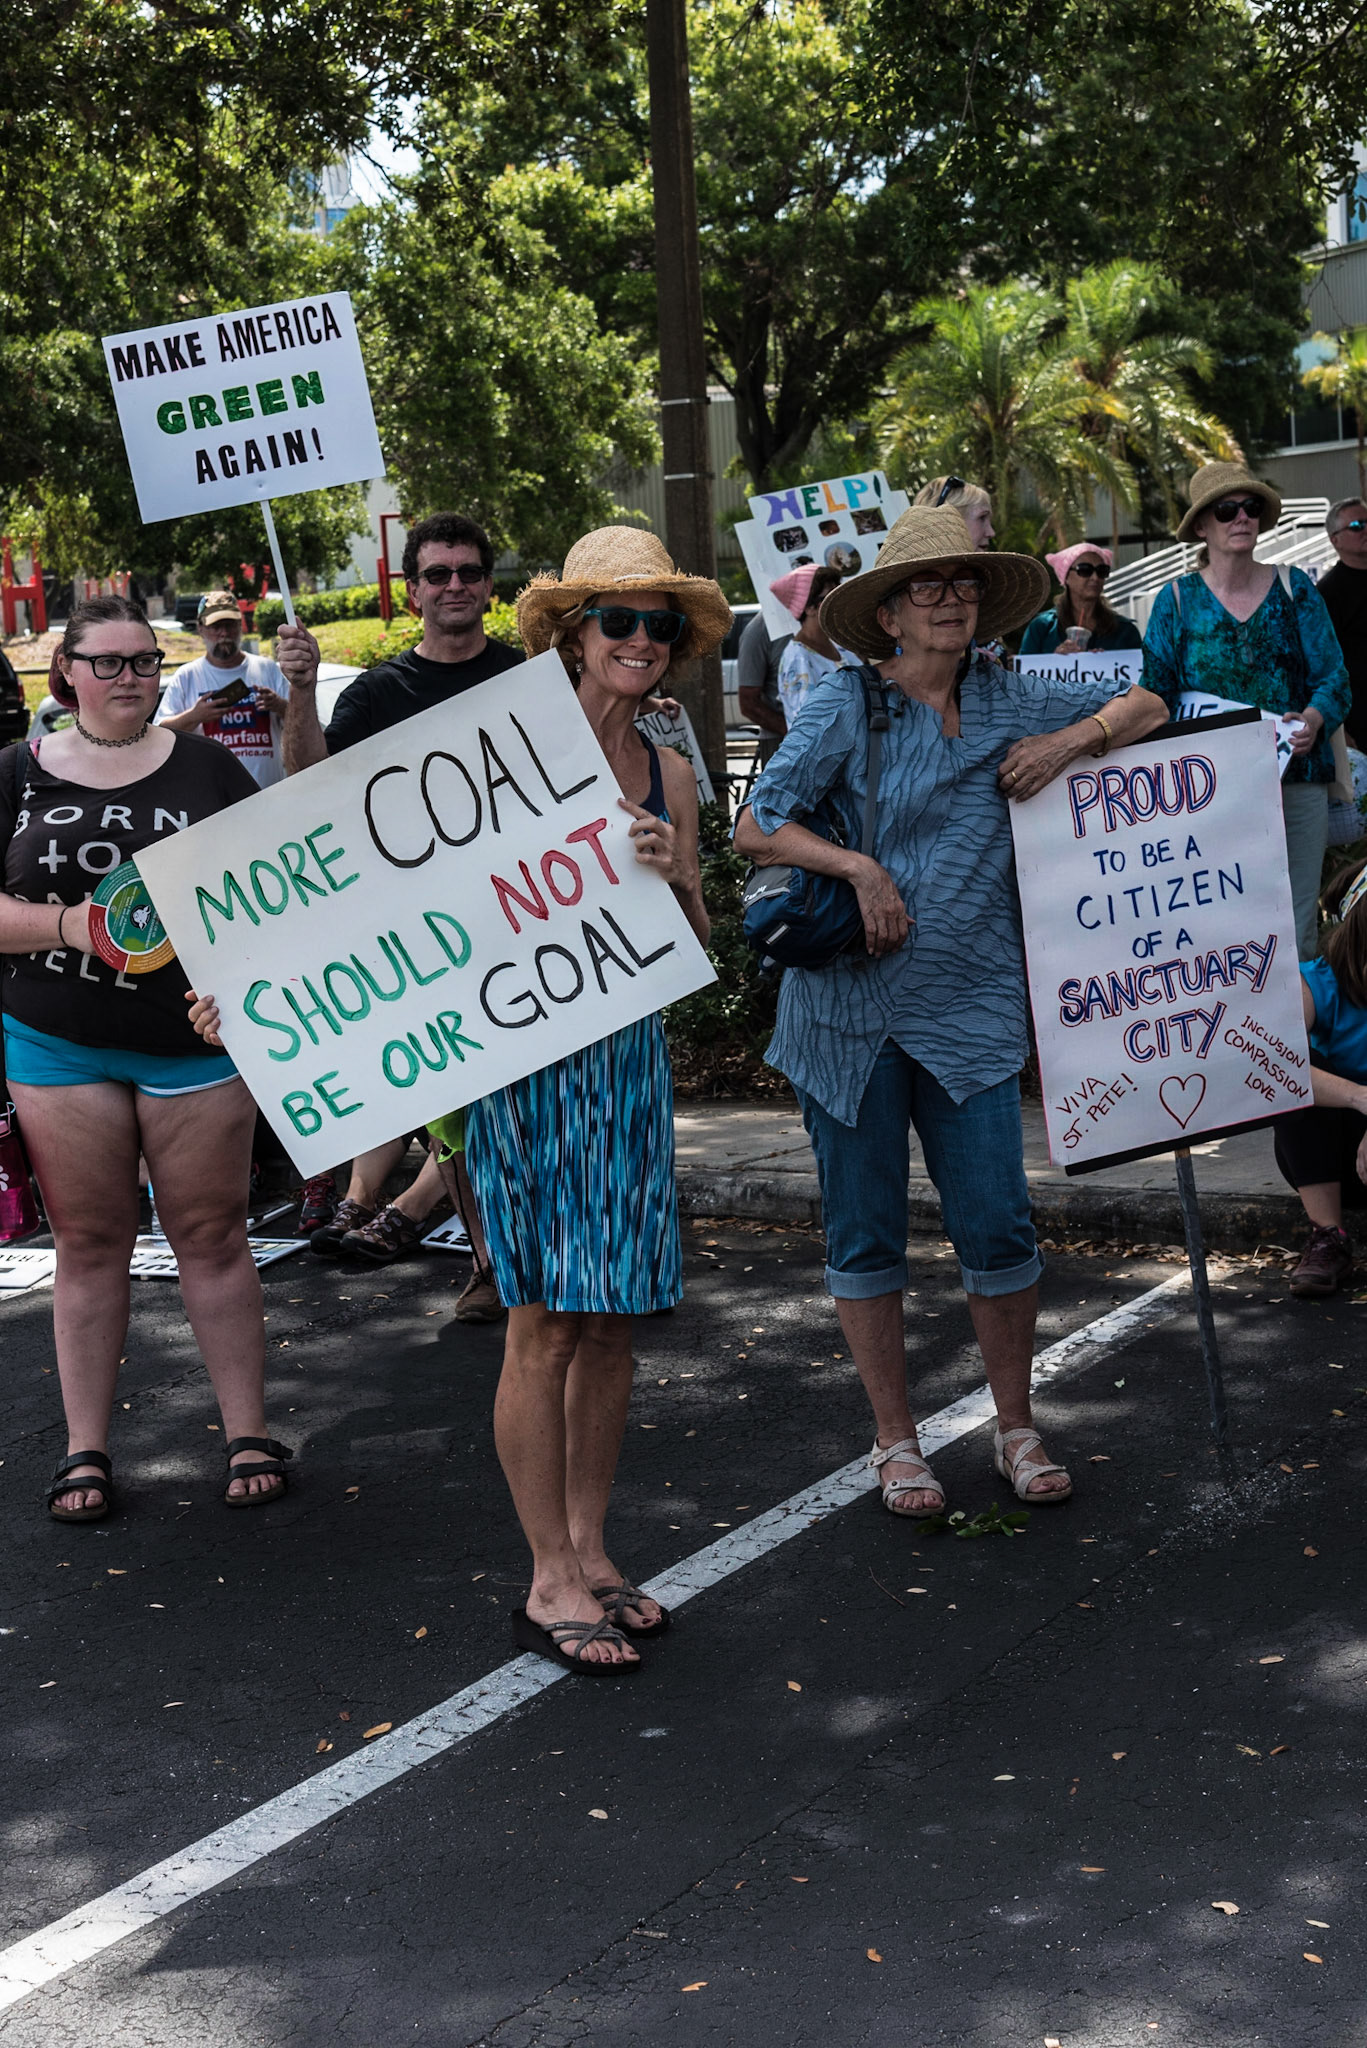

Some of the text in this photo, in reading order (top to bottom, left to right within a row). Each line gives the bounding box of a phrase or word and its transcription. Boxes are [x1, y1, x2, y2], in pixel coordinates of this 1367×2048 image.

[111, 302, 342, 381] MAKE AMERICA
[156, 371, 325, 435] GREEN
[195, 427, 325, 484] AGAIN!
[760, 474, 883, 526] HELP!
[1114, 662, 1130, 681] is
[210, 730, 269, 746] Warfare
[222, 711, 252, 724] NOT
[13, 805, 188, 838] BORN
[1067, 755, 1217, 838] PROUD
[195, 711, 598, 945] MORE COAL
[1093, 835, 1201, 875] TO BE A
[1077, 863, 1244, 929] CITIZEN
[243, 911, 473, 1061] SHOULD
[490, 818, 620, 934] NOT
[1132, 928, 1193, 958] OF A
[31, 950, 138, 991] ELL
[1058, 934, 1277, 1027] SANCTUARY
[281, 907, 676, 1137] BE OUR GOAL
[1124, 1001, 1226, 1062] CITY
[1241, 1015, 1306, 1069] INCLUSION
[1224, 1028, 1308, 1099] COMPASSION
[1244, 1070, 1276, 1102] LOVE
[1056, 1076, 1106, 1114] VIVA
[1062, 1072, 1139, 1149] ST. PETE!
